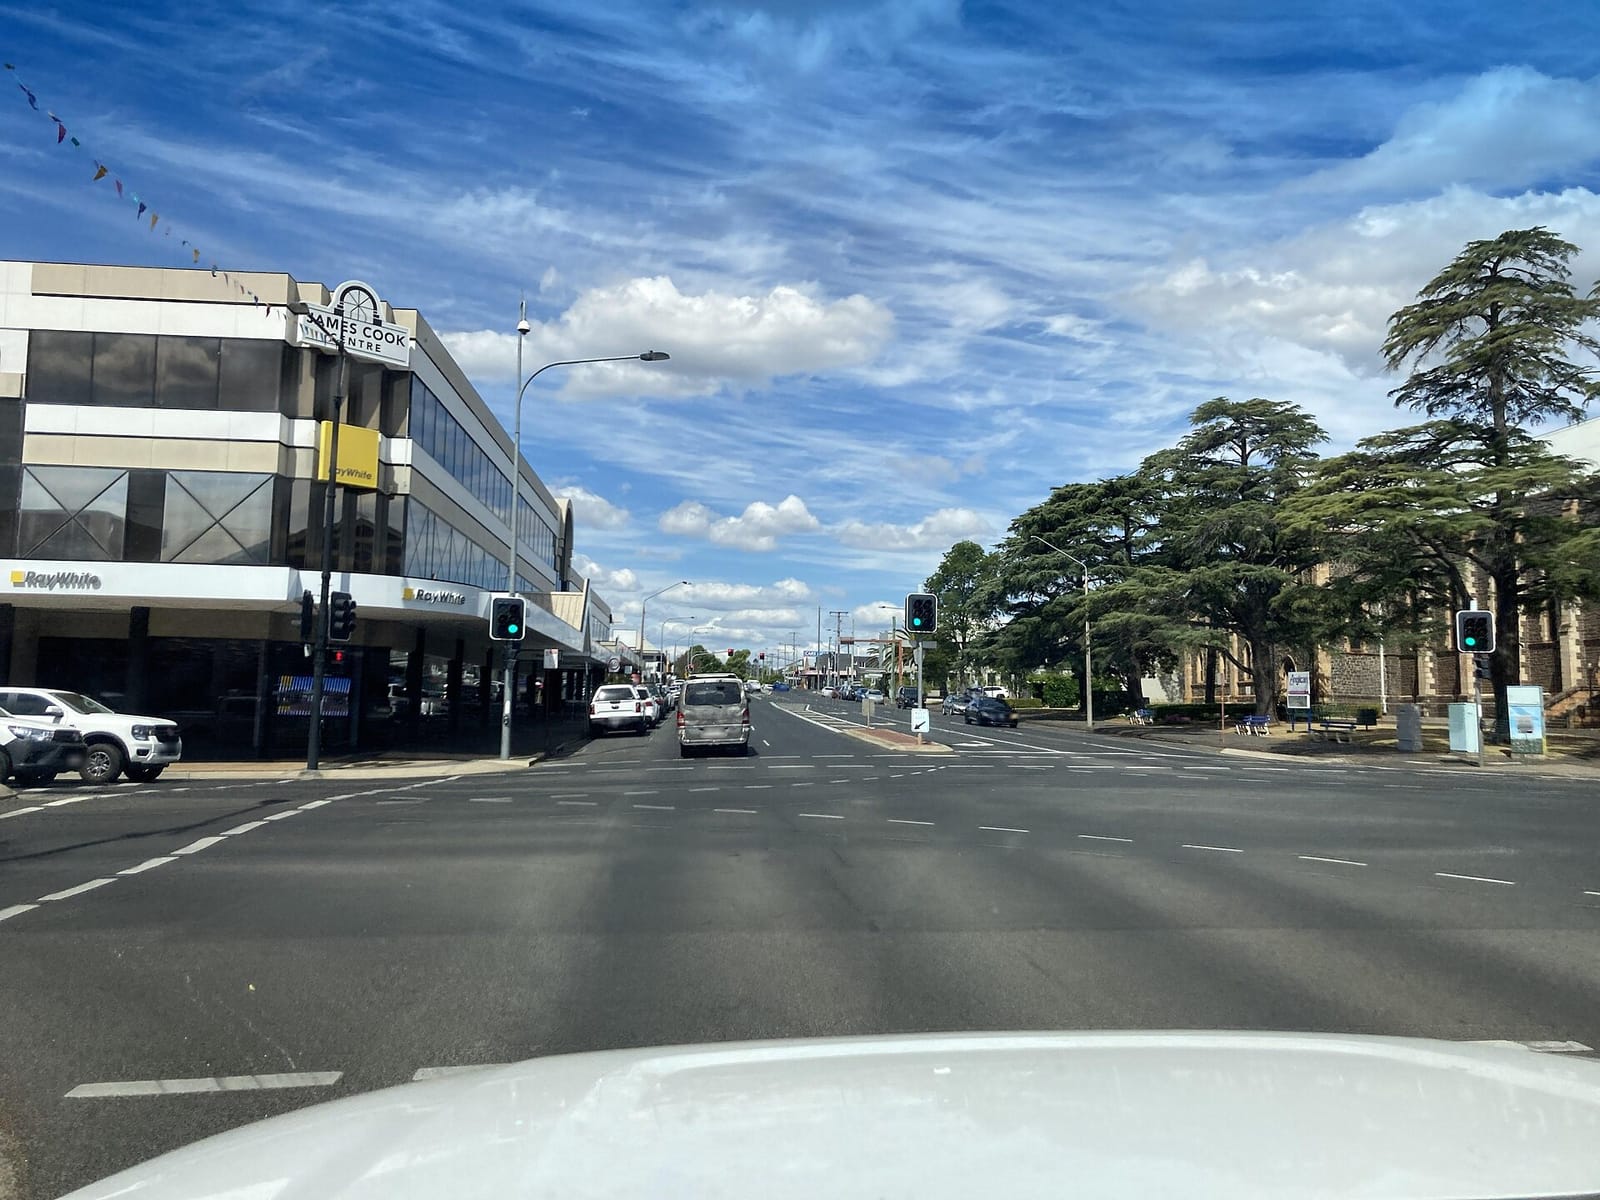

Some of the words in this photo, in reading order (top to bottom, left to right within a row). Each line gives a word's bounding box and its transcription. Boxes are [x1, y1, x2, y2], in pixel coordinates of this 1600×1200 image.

[306, 312, 357, 335] JAMES
[363, 326, 406, 348] COOK
[335, 467, 373, 480] ayWhite
